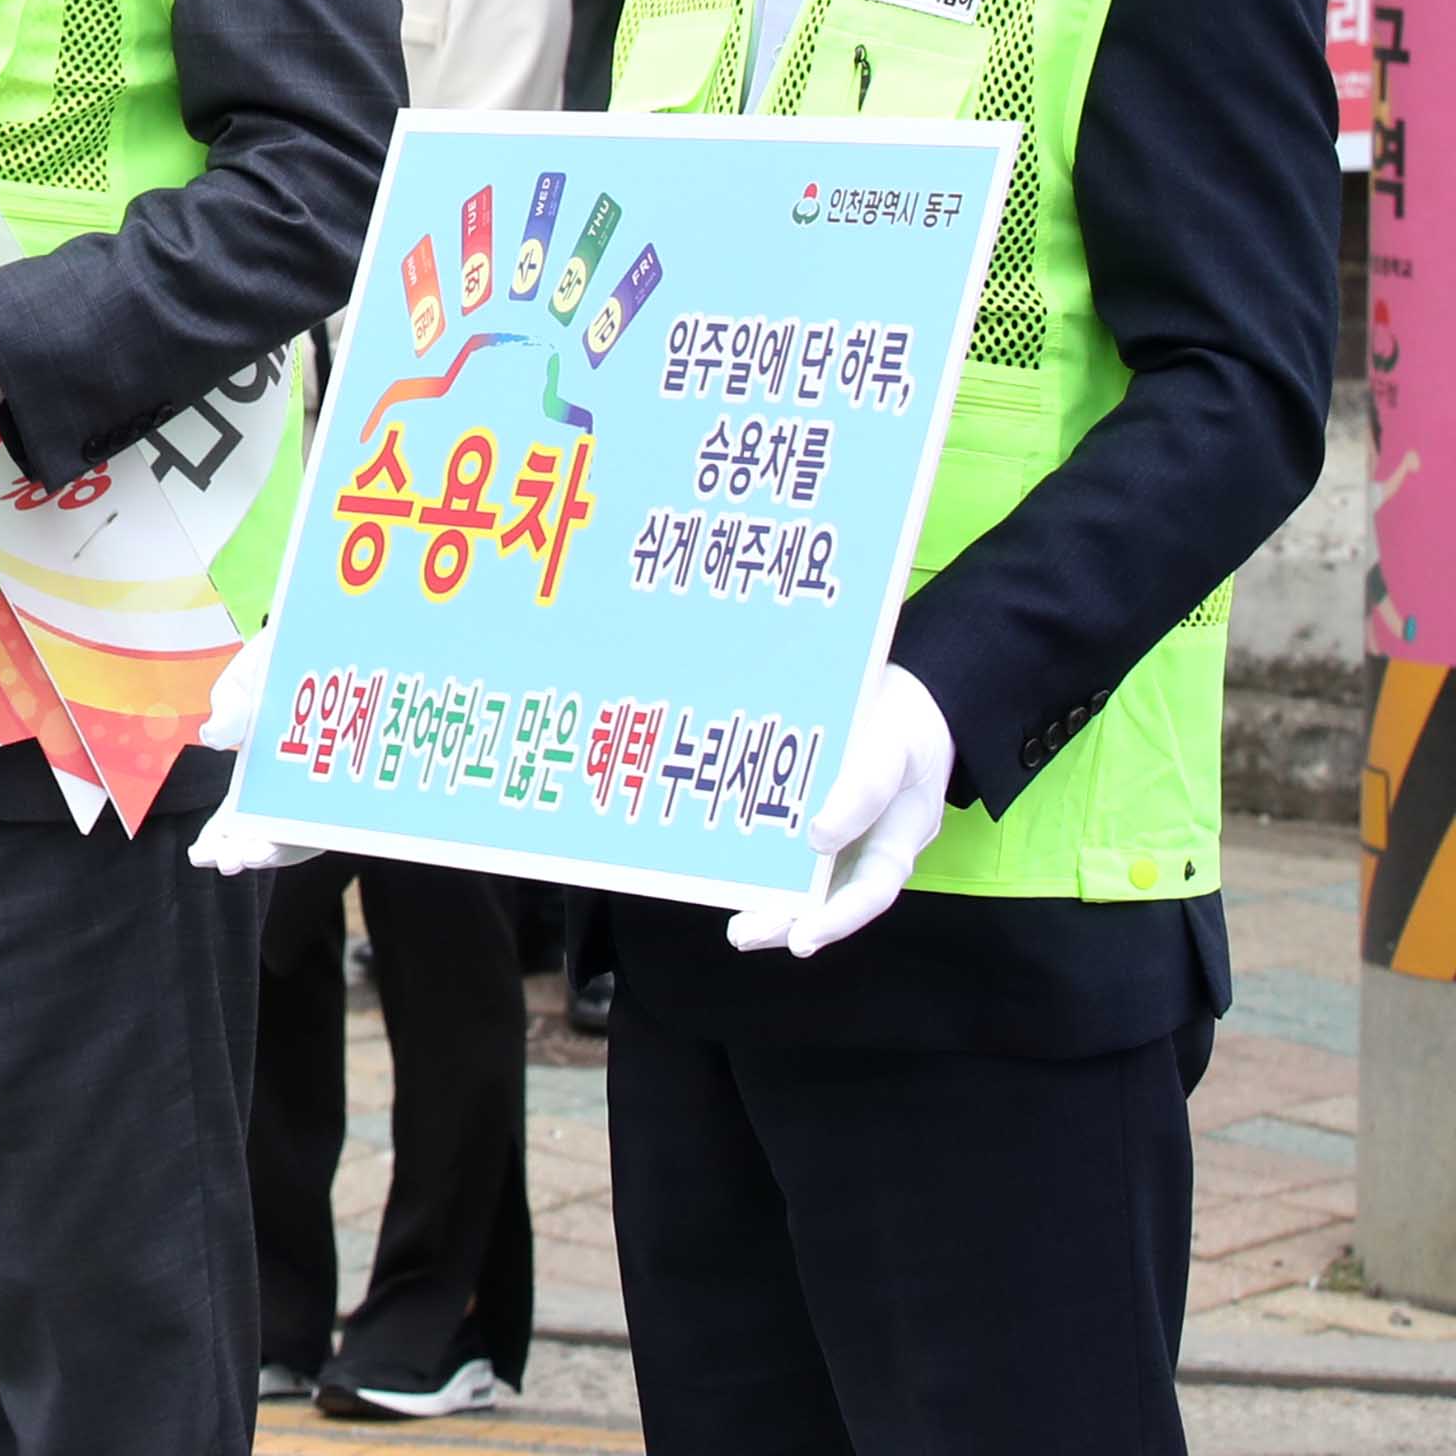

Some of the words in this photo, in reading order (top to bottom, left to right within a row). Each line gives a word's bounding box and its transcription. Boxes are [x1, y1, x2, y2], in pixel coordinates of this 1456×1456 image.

[467, 199, 478, 236] TUE
[534, 177, 552, 217] WED
[587, 200, 610, 237] THU
[631, 252, 655, 286] FRI
[825, 189, 917, 228] 인천광역시
[921, 192, 963, 228] 동구
[465, 260, 485, 297] 화
[518, 247, 537, 283] 수
[558, 268, 582, 301] 목
[594, 306, 617, 344] 금
[663, 317, 789, 395] 일주일에
[798, 325, 832, 395] 단
[836, 331, 914, 409] 하루,
[696, 423, 830, 501] 승용차를
[336, 429, 593, 601] 승용차
[633, 514, 698, 587] 쉬게
[704, 523, 838, 602] 해주세요.
[281, 672, 376, 776] 요일제
[381, 680, 504, 785] 참여하고
[506, 692, 576, 803] 많은
[584, 702, 659, 817] 혜택
[661, 712, 820, 831] 누리세요!
